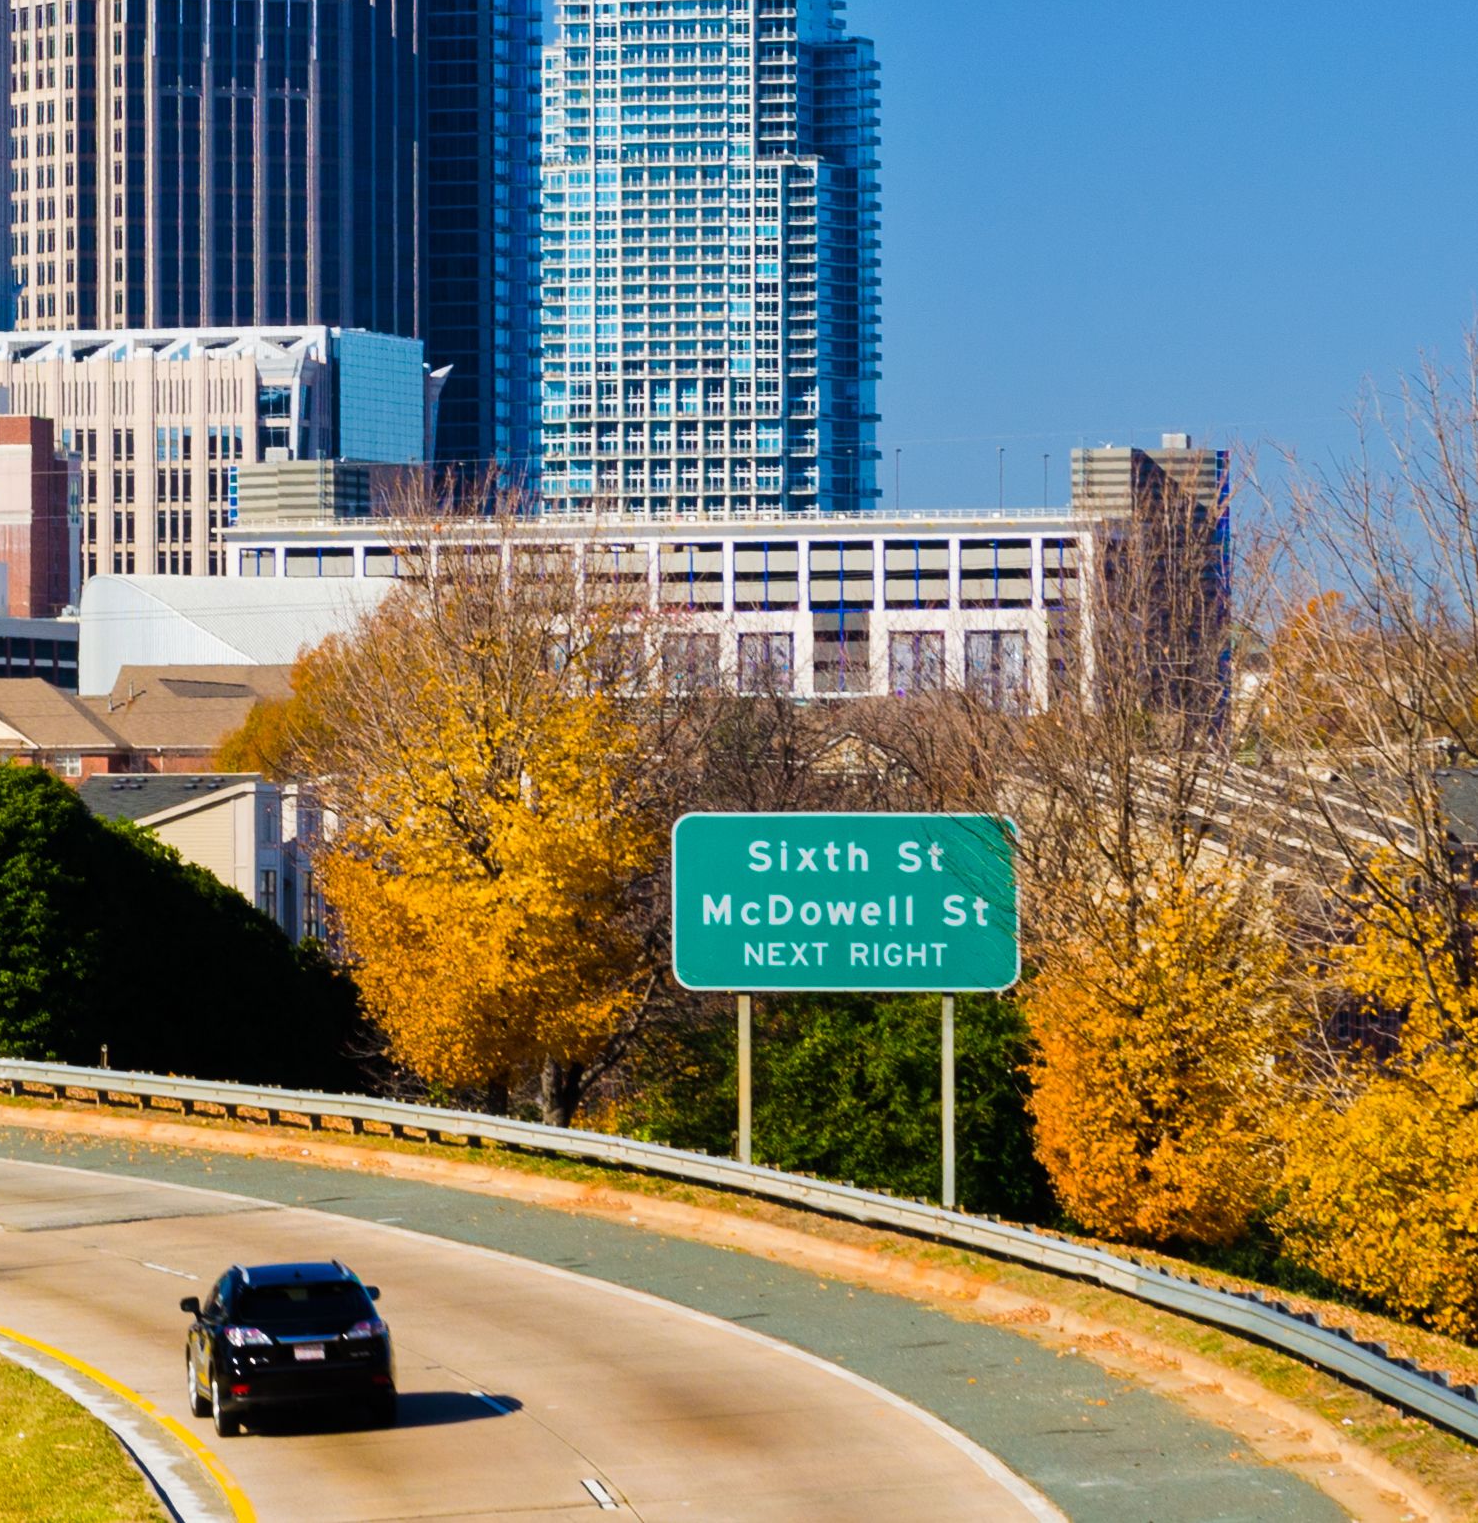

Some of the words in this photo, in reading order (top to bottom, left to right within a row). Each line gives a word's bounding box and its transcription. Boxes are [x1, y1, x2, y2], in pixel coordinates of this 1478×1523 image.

[747, 840, 869, 872] Sixth
[898, 841, 945, 873] St
[702, 894, 913, 926] McDowell
[943, 894, 989, 927] St
[743, 942, 829, 966] NEXT
[850, 942, 948, 967] RIGHT
